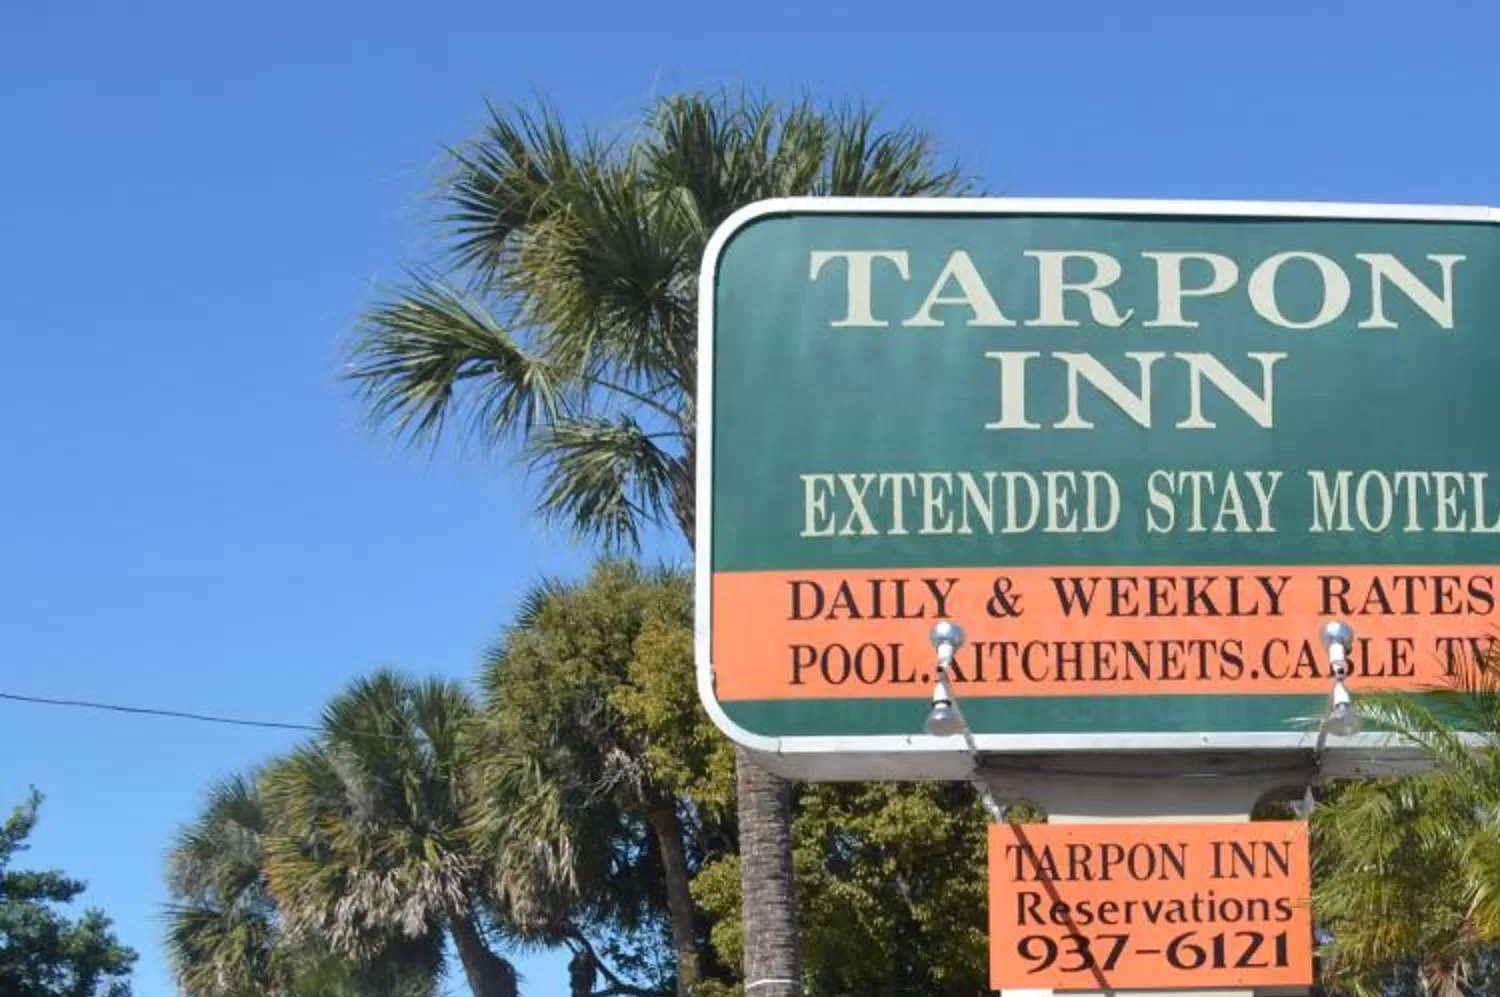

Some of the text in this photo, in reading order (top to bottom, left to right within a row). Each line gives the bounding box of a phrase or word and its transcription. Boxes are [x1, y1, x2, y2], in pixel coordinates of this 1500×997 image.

[809, 249, 1466, 330] TARPON
[985, 351, 1288, 430] INN
[799, 470, 1122, 537] EXTENDED
[1146, 469, 1284, 534] STAY
[787, 575, 1496, 621] DAILY & WEEKLY RATES
[1435, 636, 1498, 677] TV
[1005, 841, 1292, 882] TARPON INN
[1016, 889, 1293, 926] Reservations
[1016, 930, 1290, 975] 937-6121
